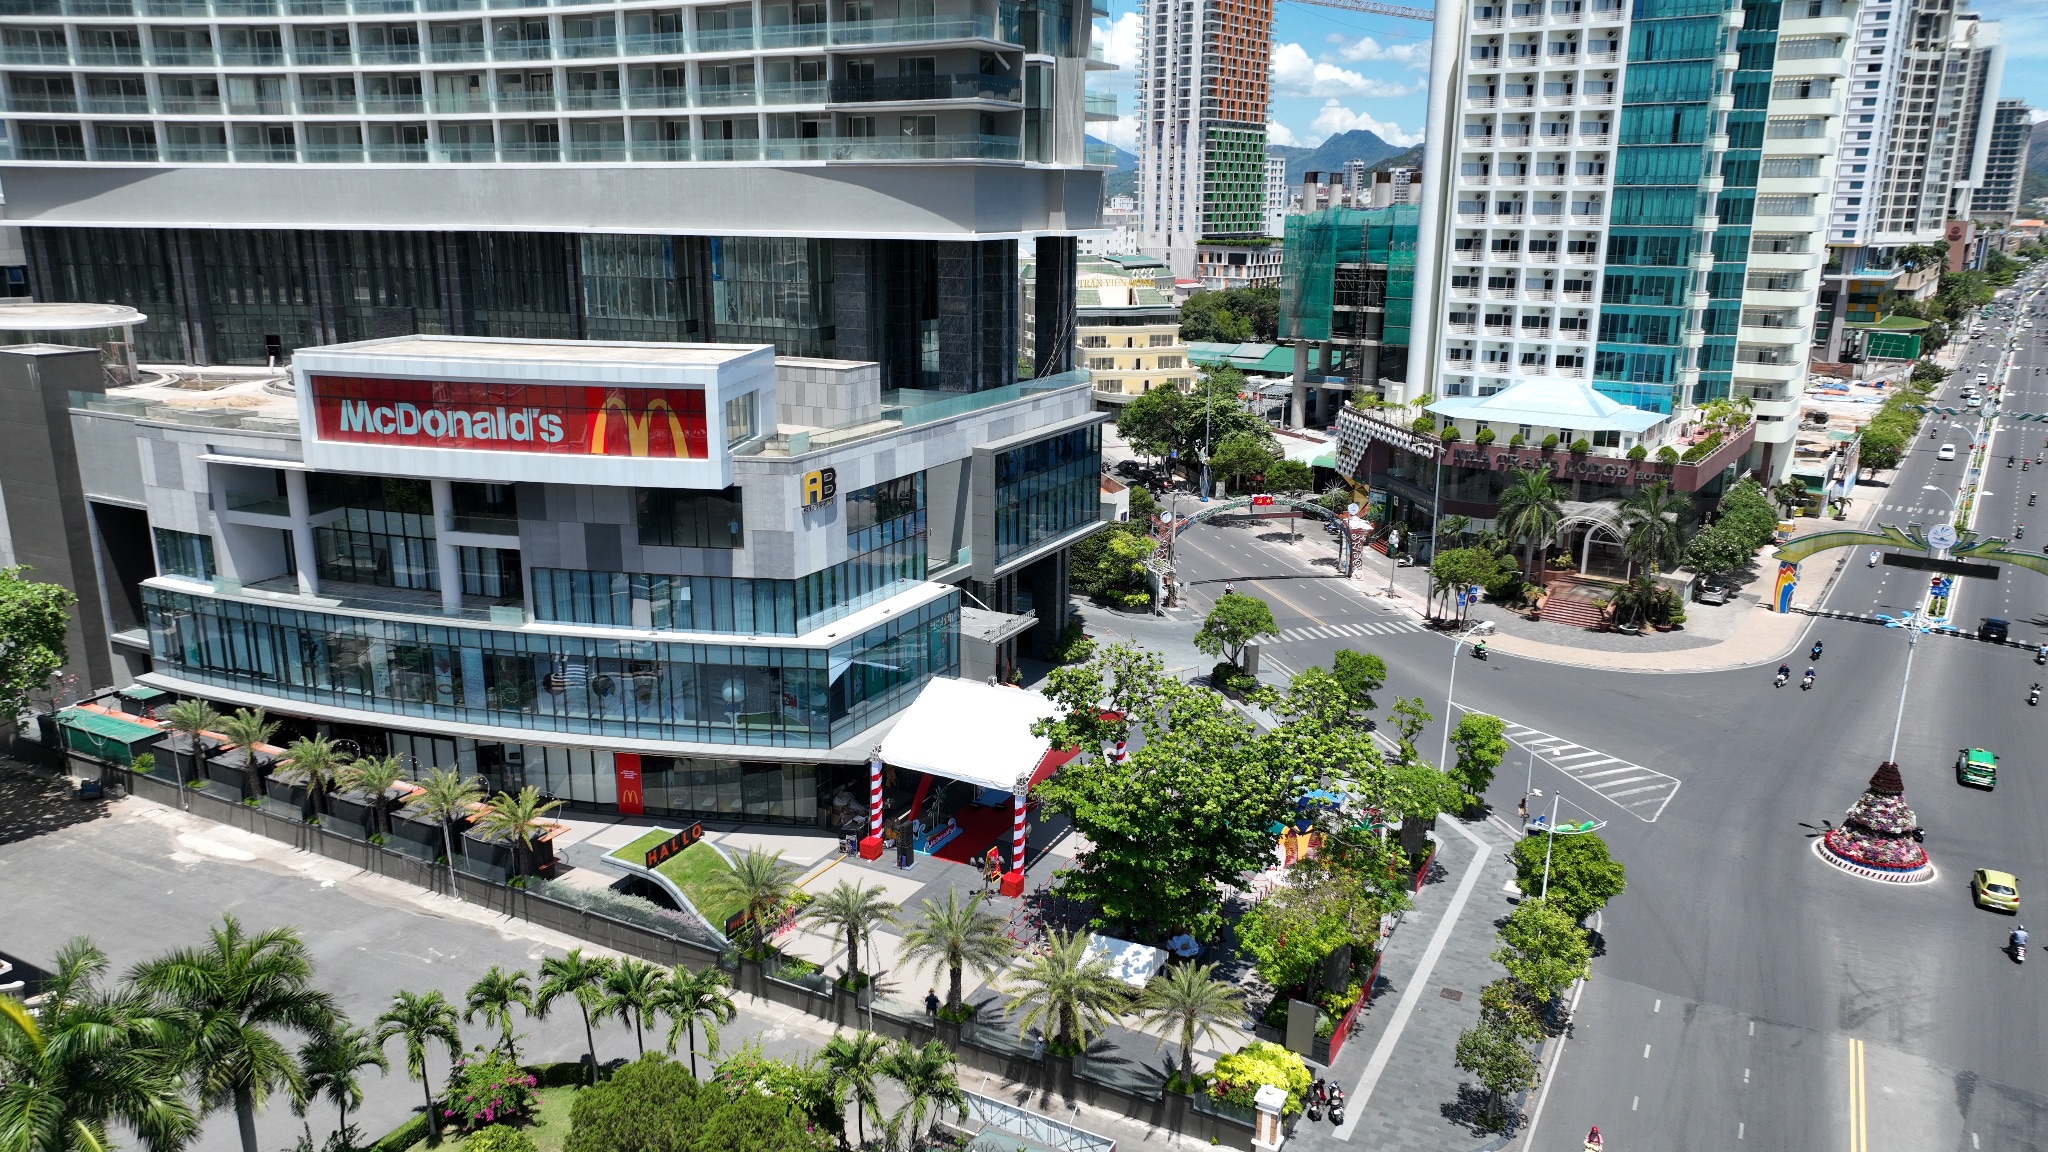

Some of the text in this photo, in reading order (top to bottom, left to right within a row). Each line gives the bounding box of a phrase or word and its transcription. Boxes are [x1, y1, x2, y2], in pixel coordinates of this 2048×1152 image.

[339, 400, 564, 443] McDonald's
[1453, 448, 1674, 484] NHA TRANG LODGE HOTEL
[647, 823, 702, 867] HALLO
